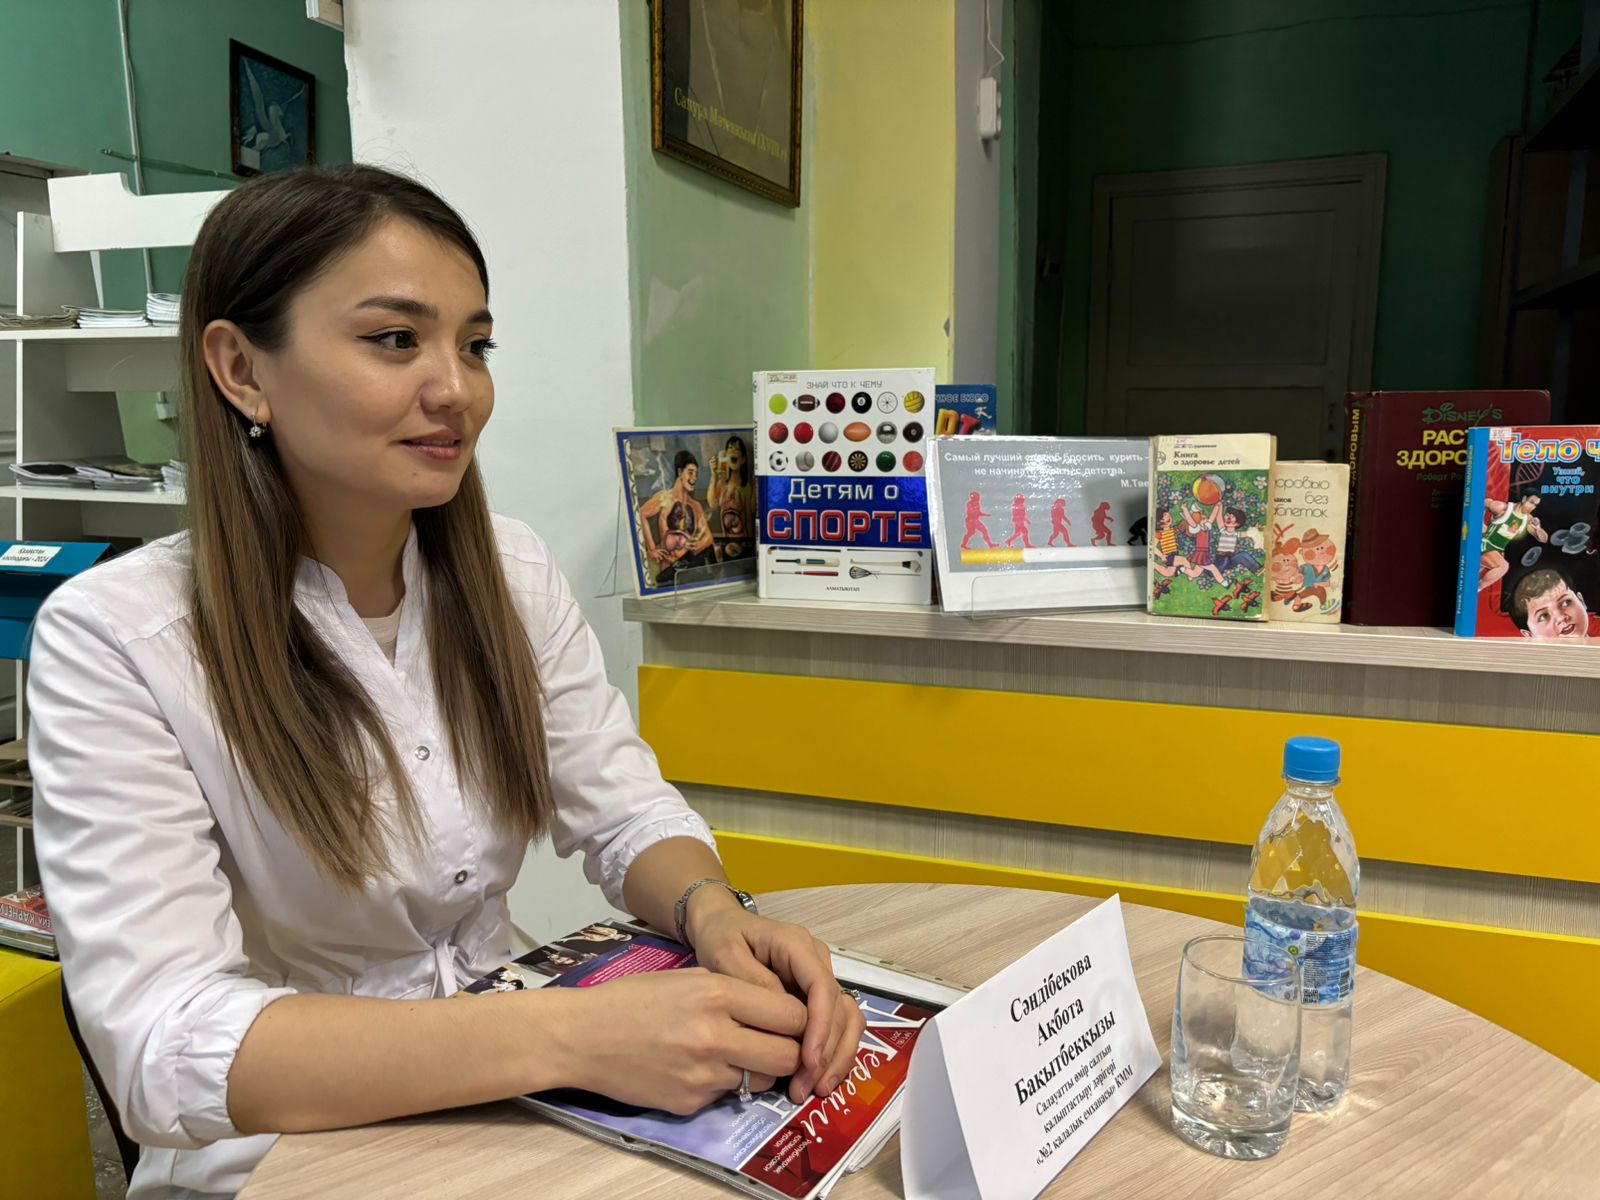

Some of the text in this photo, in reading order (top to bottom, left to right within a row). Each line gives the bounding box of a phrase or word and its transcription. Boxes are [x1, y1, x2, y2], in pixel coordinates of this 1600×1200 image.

[806, 380, 883, 389] ЗНАЙ ЧТО К ЧЕМУ
[1422, 429, 1468, 446] РАС
[1496, 432, 1583, 463] Тело
[944, 452, 981, 462] Самый
[983, 452, 1023, 464] лучший
[1063, 452, 1105, 463] бросить
[1109, 453, 1144, 463] курить
[1174, 451, 1199, 459] Книга
[1181, 459, 1216, 467] здоровье
[974, 467, 987, 475] не
[1556, 476, 1581, 485] что
[788, 478, 899, 504] Детям о
[1304, 491, 1329, 505] без
[1541, 485, 1595, 497] внутри
[767, 509, 923, 543] СПОРТЕ
[1010, 954, 1092, 1023] Сәндібекова
[1037, 998, 1084, 1047] Ақбота
[1014, 1010, 1116, 1106] Бақытбекқызы
[1036, 1044, 1112, 1116] Салауатты өмір салтын
[1092, 1058, 1117, 1089] дәрігері
[1114, 1064, 1134, 1089] КММ
